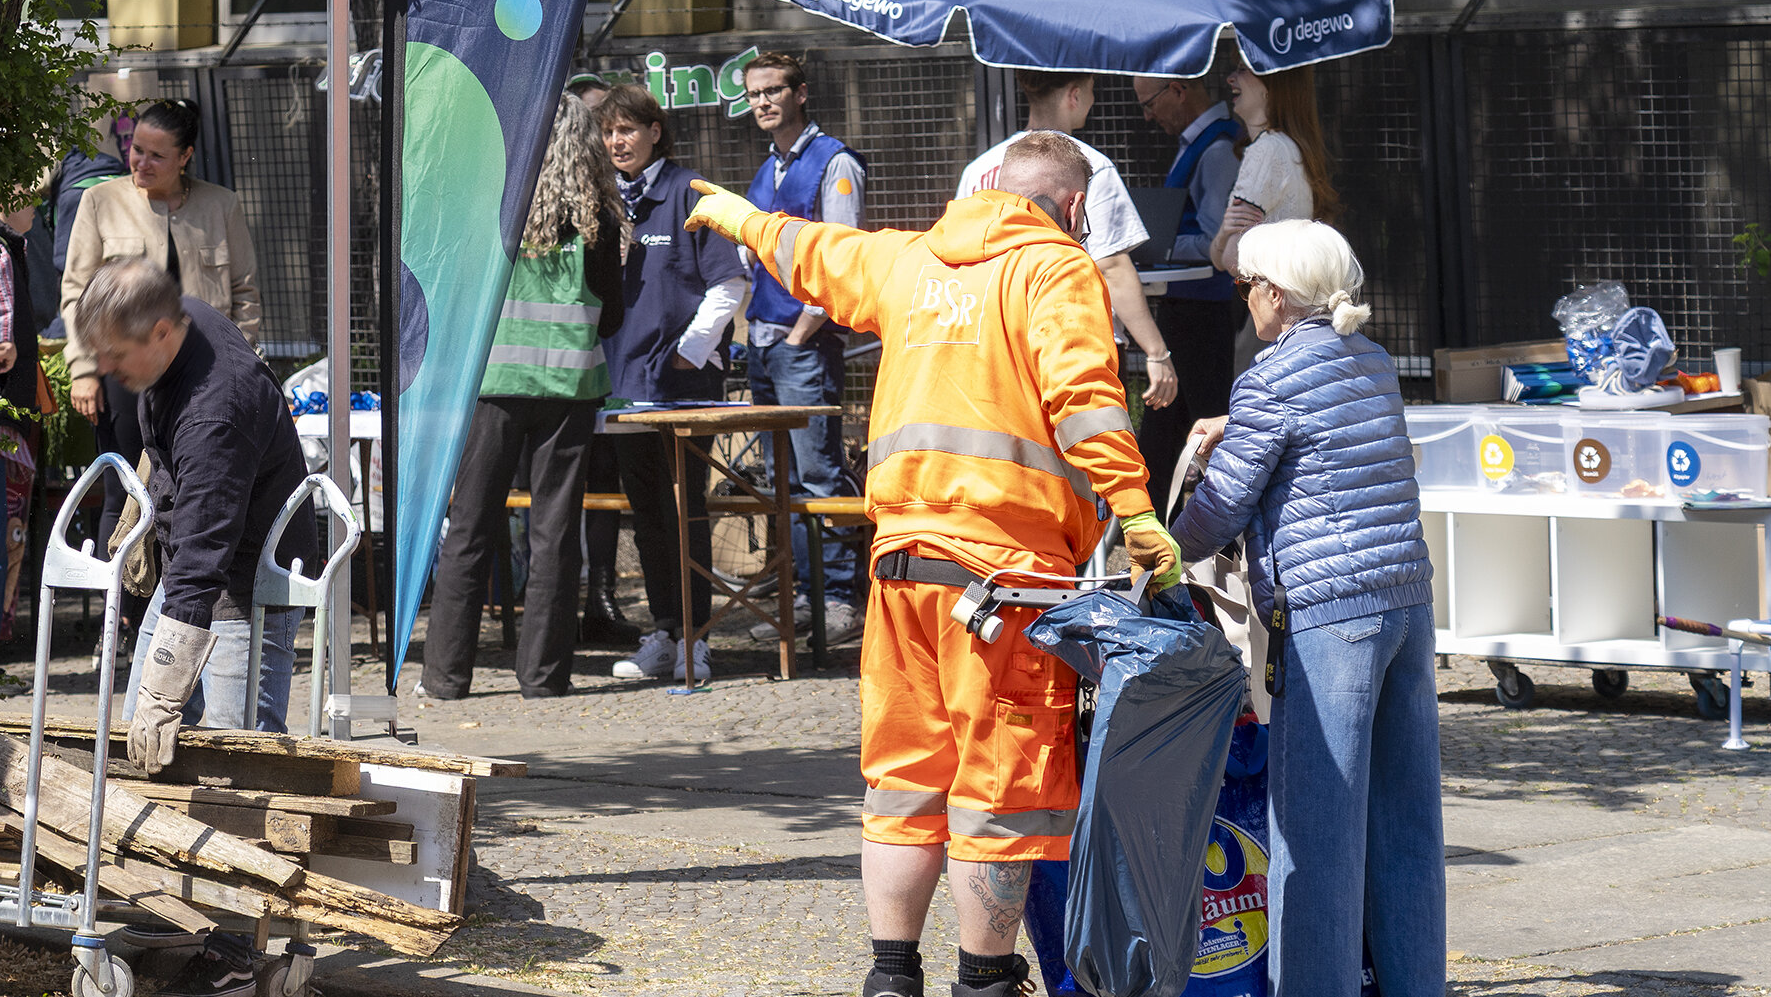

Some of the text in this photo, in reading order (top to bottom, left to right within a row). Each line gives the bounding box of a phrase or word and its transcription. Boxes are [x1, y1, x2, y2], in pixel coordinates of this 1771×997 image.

[1295, 12, 1354, 43] degewo
[920, 278, 977, 327] BSR
[1201, 892, 1266, 923] äum
